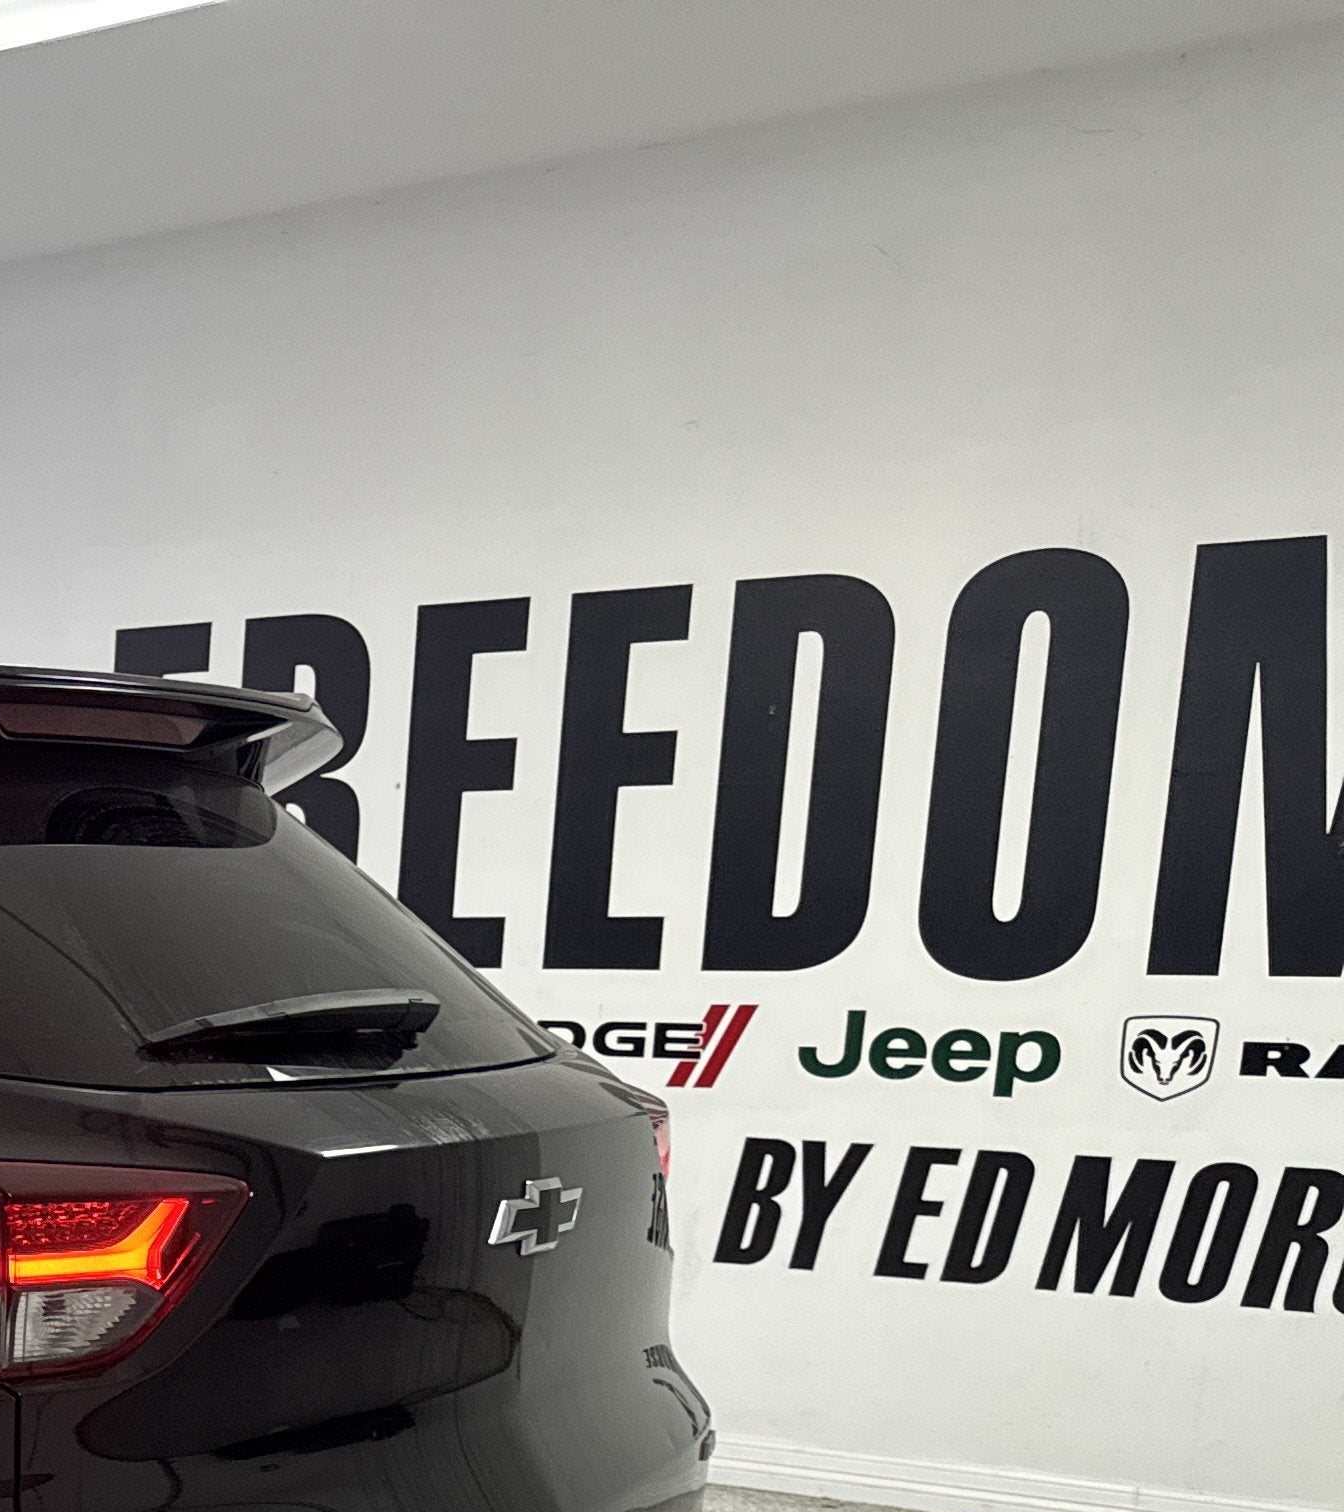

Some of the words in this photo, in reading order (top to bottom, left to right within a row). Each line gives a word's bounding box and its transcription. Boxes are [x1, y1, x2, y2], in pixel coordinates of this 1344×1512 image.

[798, 1009, 1062, 1098] Jeep
[712, 1136, 875, 1271] BY
[872, 1144, 1036, 1285] ED
[1035, 1154, 1344, 1314] MOR
